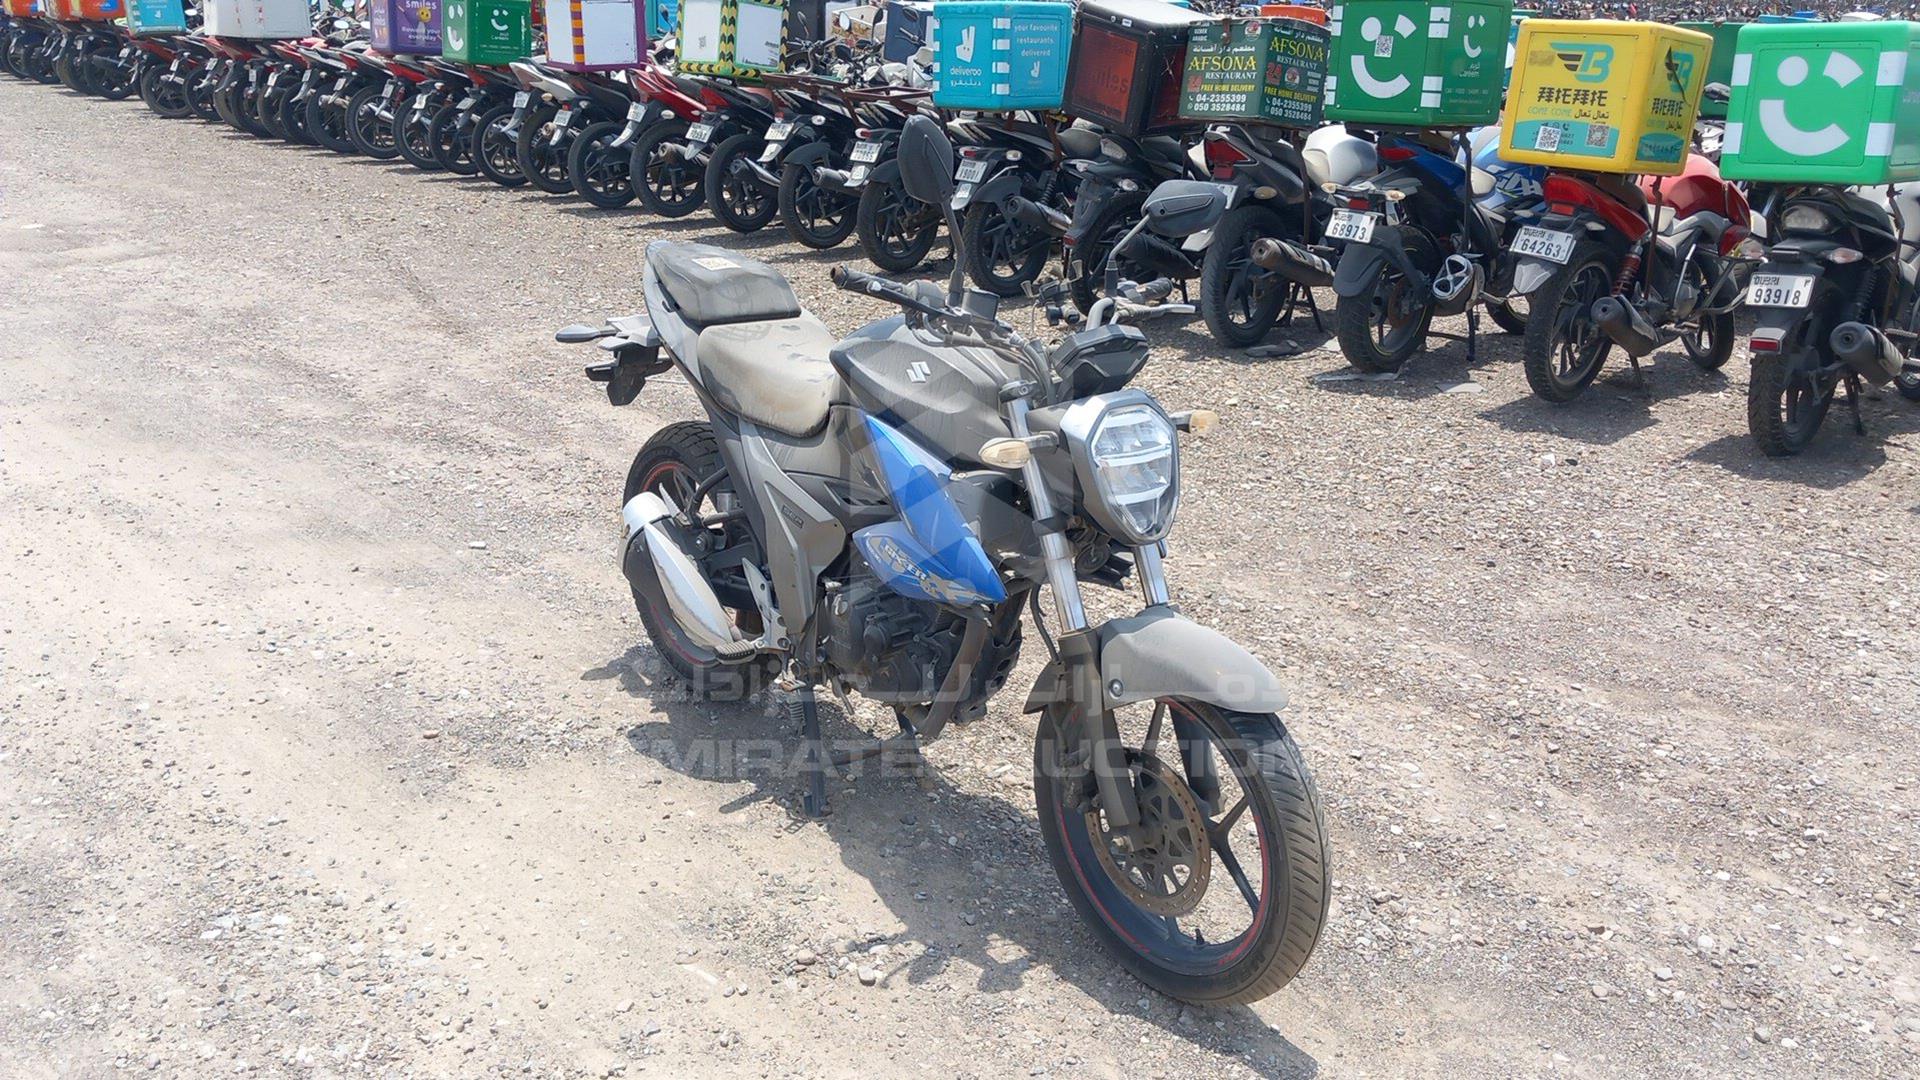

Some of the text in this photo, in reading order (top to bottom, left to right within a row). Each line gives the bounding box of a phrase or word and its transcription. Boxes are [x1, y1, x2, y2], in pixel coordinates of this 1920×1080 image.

[1021, 48, 1051, 56] delivered
[1269, 36, 1324, 62] AFSONA
[1187, 55, 1257, 71] AFSONA
[1276, 54, 1318, 70] RESTAURANT
[950, 65, 982, 77] deliveroo
[1205, 71, 1258, 79] RESTAURANT
[1201, 84, 1213, 92] FREE
[1231, 84, 1256, 92] DELIVERY
[1264, 86, 1278, 96] FREE
[1294, 91, 1317, 103] DELIVERY
[1196, 94, 1247, 103] 04-2355399
[1271, 97, 1312, 113] 04-2355399
[1193, 103, 1246, 112] 050 3528484
[1270, 106, 1284, 116] 050
[1331, 222, 1367, 240] 68973
[1521, 238, 1561, 258] 64263
[1754, 288, 1801, 305] 93918
